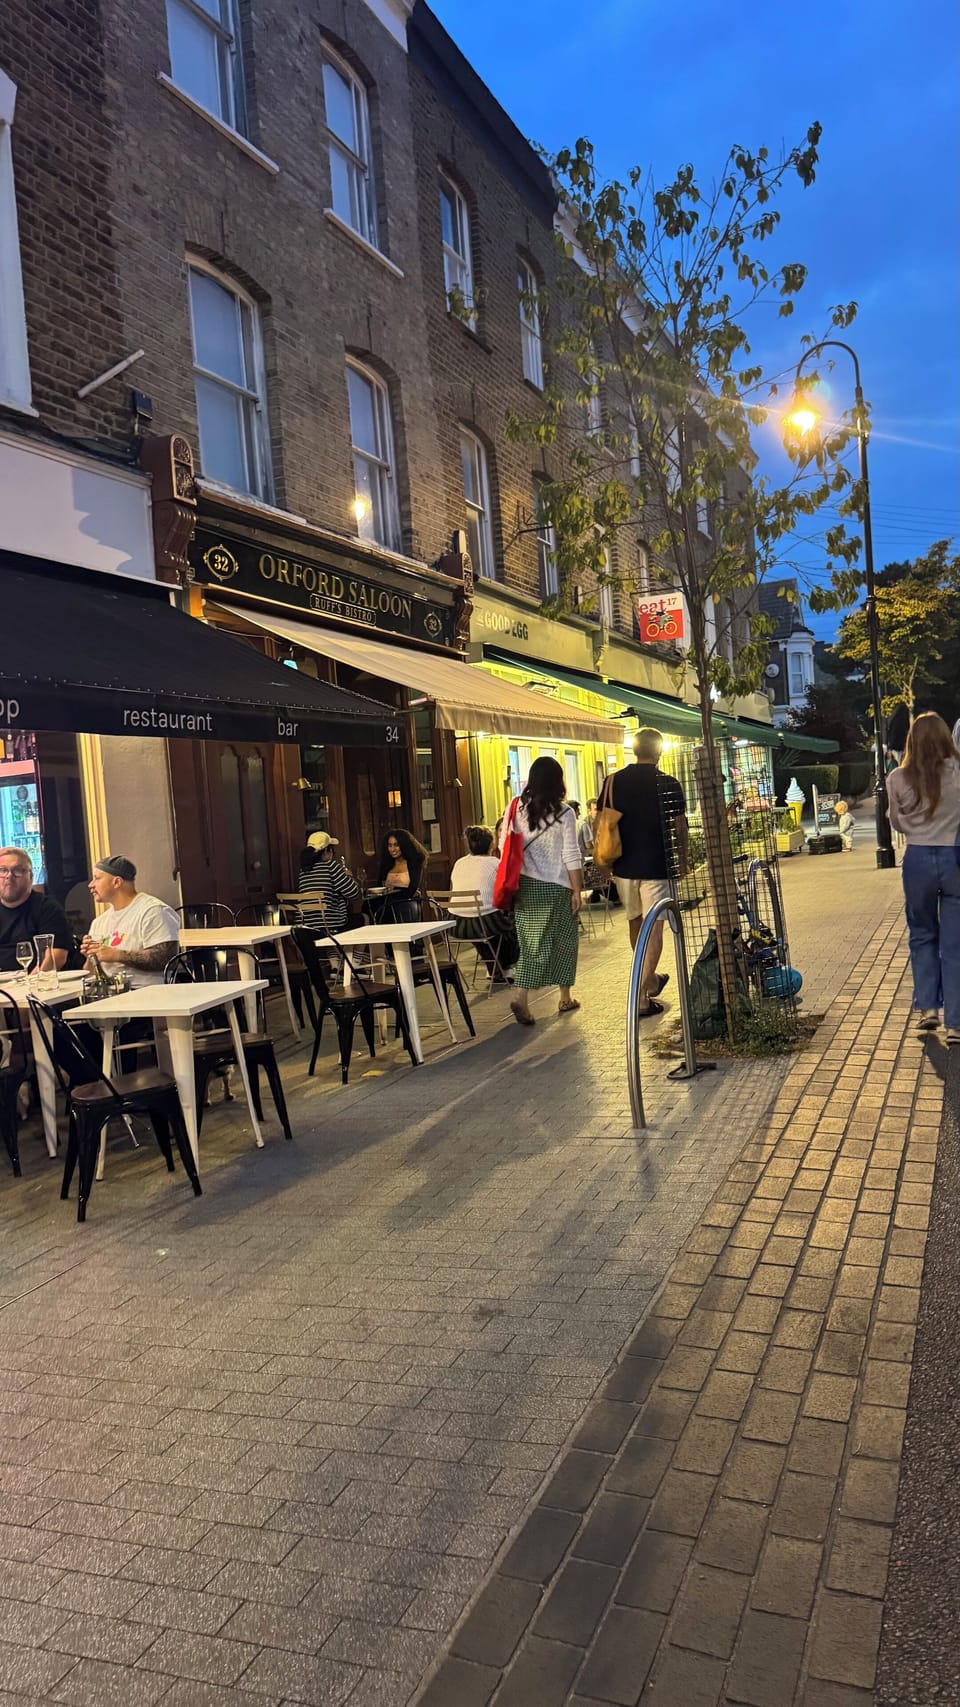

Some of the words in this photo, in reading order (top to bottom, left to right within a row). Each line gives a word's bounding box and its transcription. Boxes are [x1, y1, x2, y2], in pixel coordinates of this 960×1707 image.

[214, 554, 229, 572] 32
[259, 554, 345, 599] ORFORD
[348, 582, 412, 621] SALOON
[315, 597, 342, 614] RUFF'S
[345, 605, 372, 621] BISTRO
[484, 610, 510, 634] GOOD
[123, 708, 213, 732] restaurant
[277, 717, 299, 736] bar
[385, 726, 400, 743] 34
